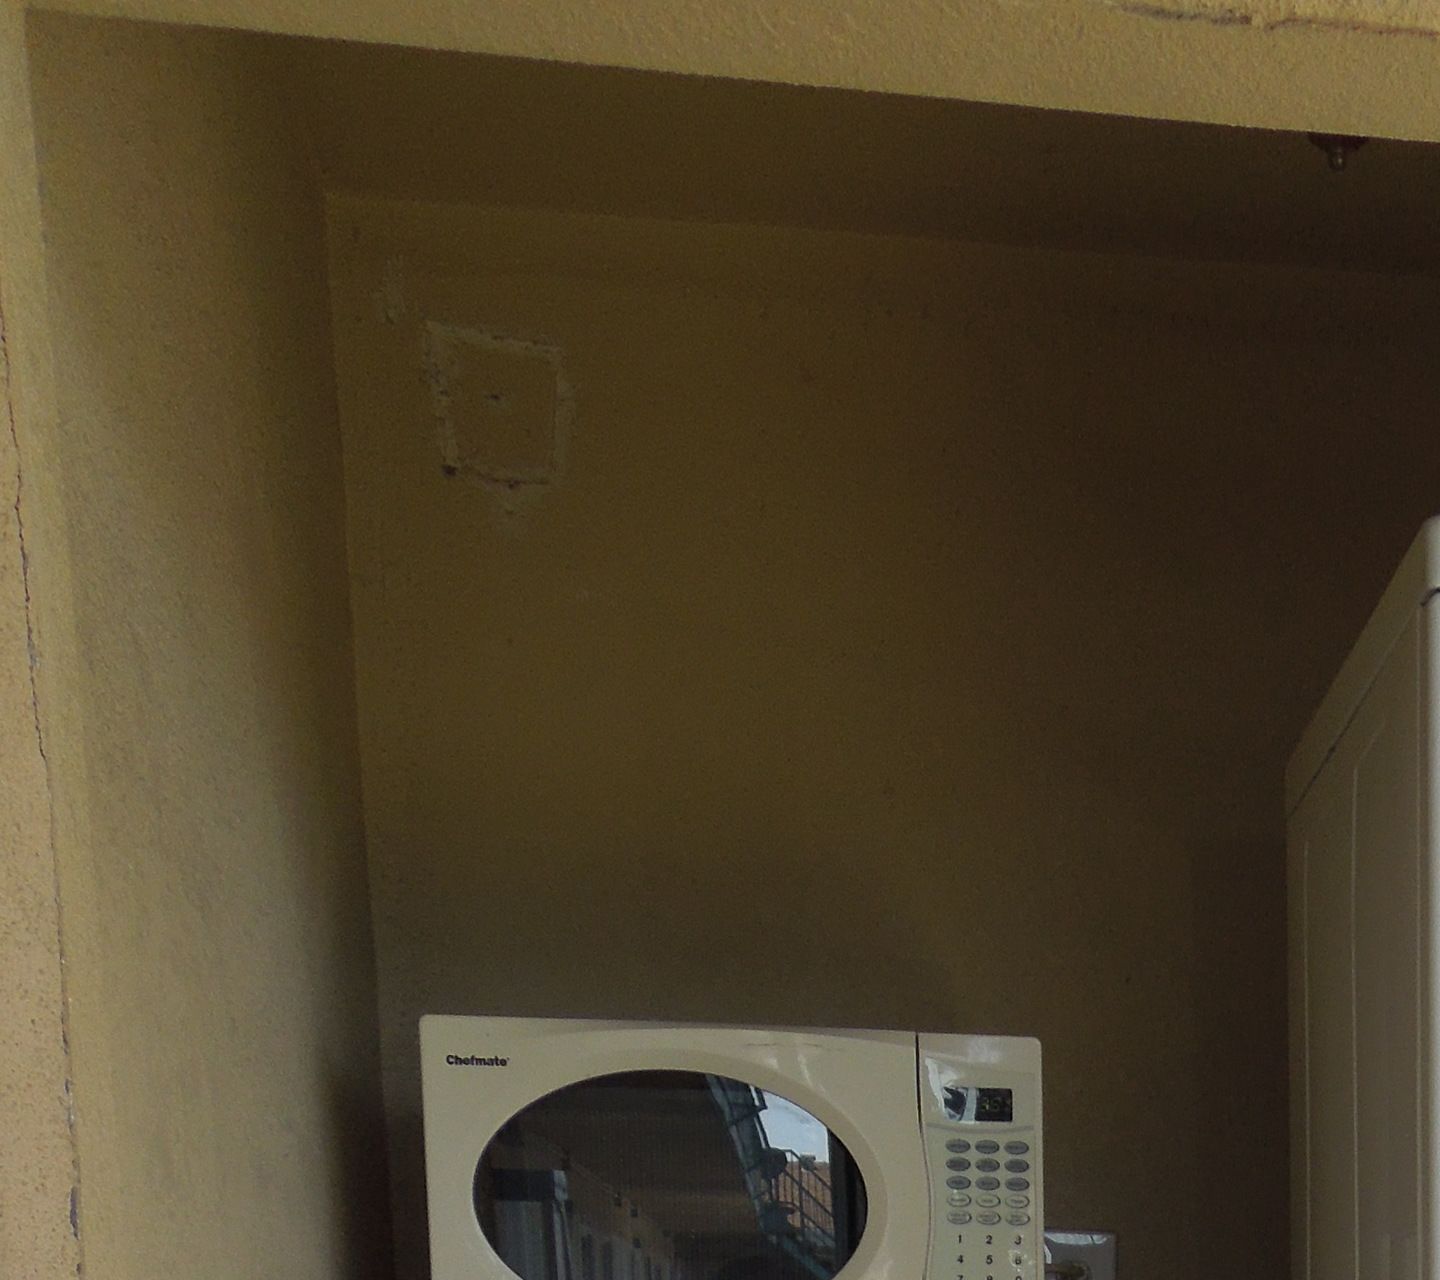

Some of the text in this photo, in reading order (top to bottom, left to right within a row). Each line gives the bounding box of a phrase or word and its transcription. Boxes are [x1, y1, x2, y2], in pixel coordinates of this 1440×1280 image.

[446, 1054, 508, 1067] Chefmate
[957, 1234, 1023, 1245] 1 2 3
[956, 1254, 1022, 1265] 4 5 6
